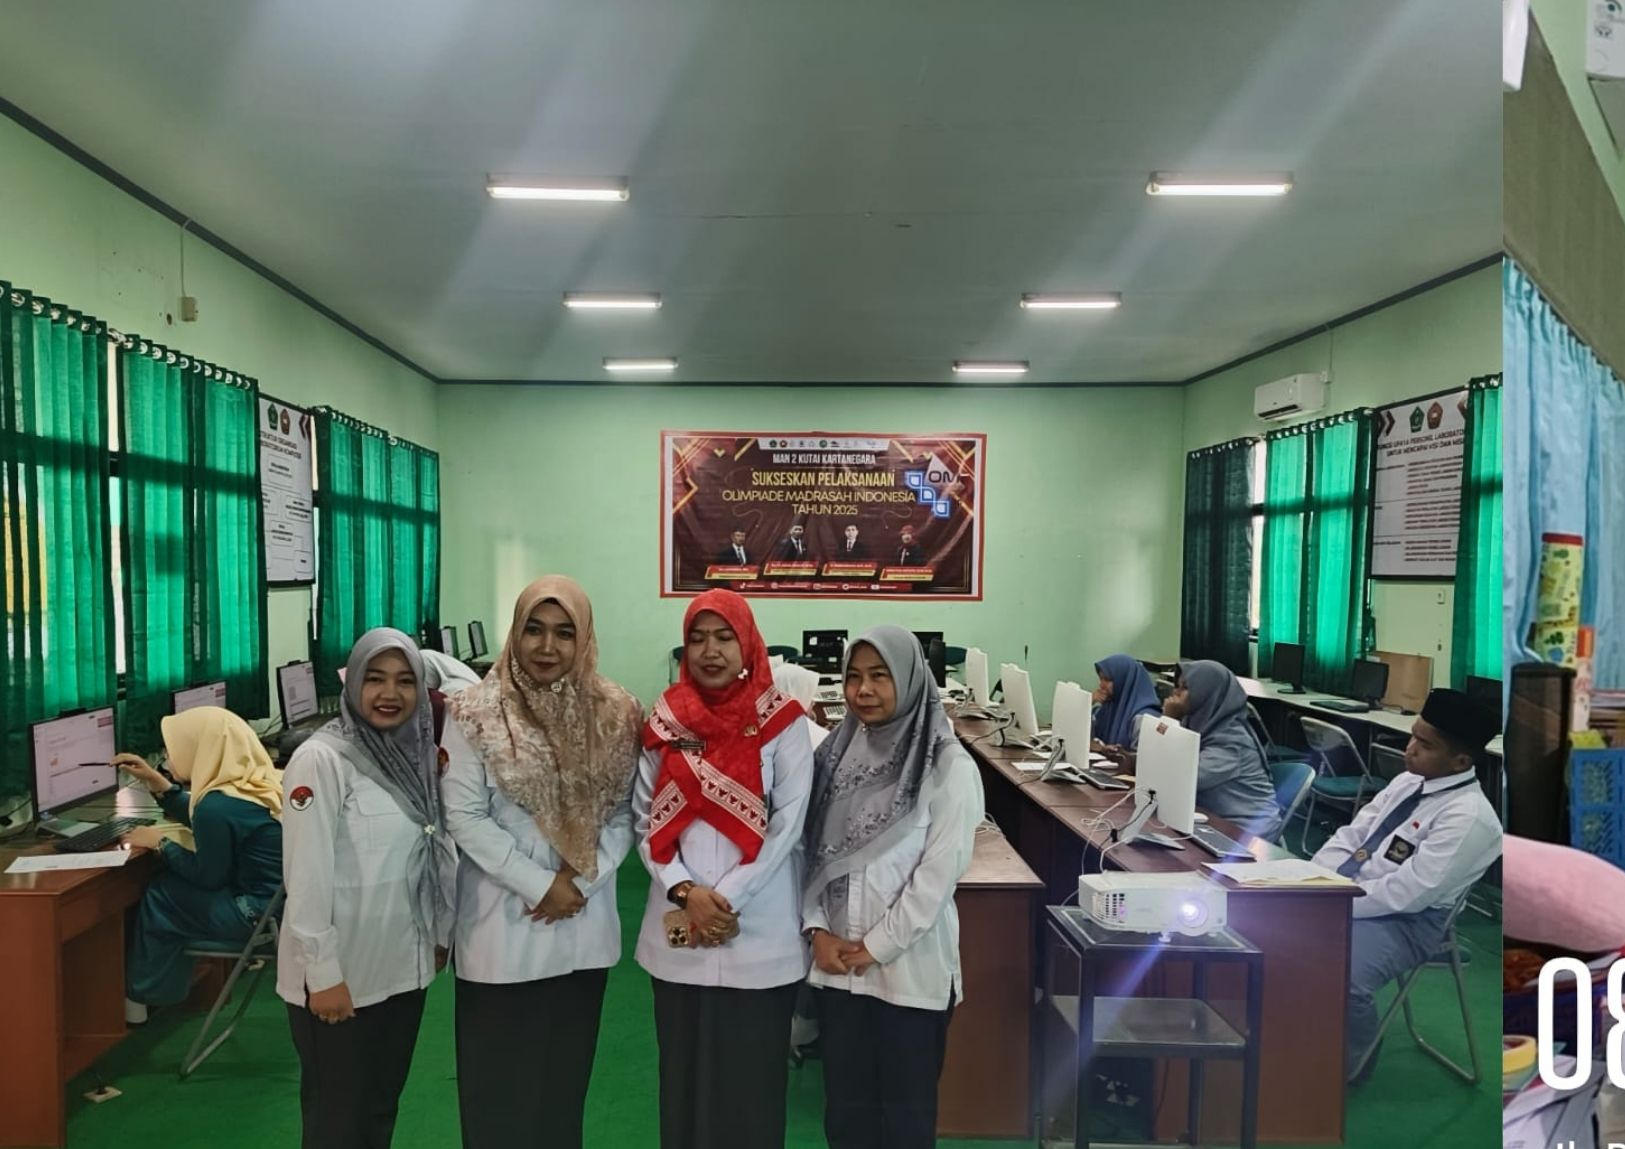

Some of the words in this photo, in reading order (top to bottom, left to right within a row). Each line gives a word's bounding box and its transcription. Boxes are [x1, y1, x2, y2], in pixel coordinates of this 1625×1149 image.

[773, 453, 790, 464] MAN
[791, 454, 797, 464] 2
[798, 454, 820, 464] KUTAI
[821, 454, 876, 465] KARTANEGARA
[752, 471, 815, 487] SUKSESKAN
[818, 471, 895, 487] PELAKSANAAN
[722, 490, 784, 502] OLIMPIADE
[785, 490, 851, 502] MADRASAH
[854, 491, 916, 503] INDONESIA
[792, 504, 832, 515] TAHUN
[833, 504, 858, 515] 2025
